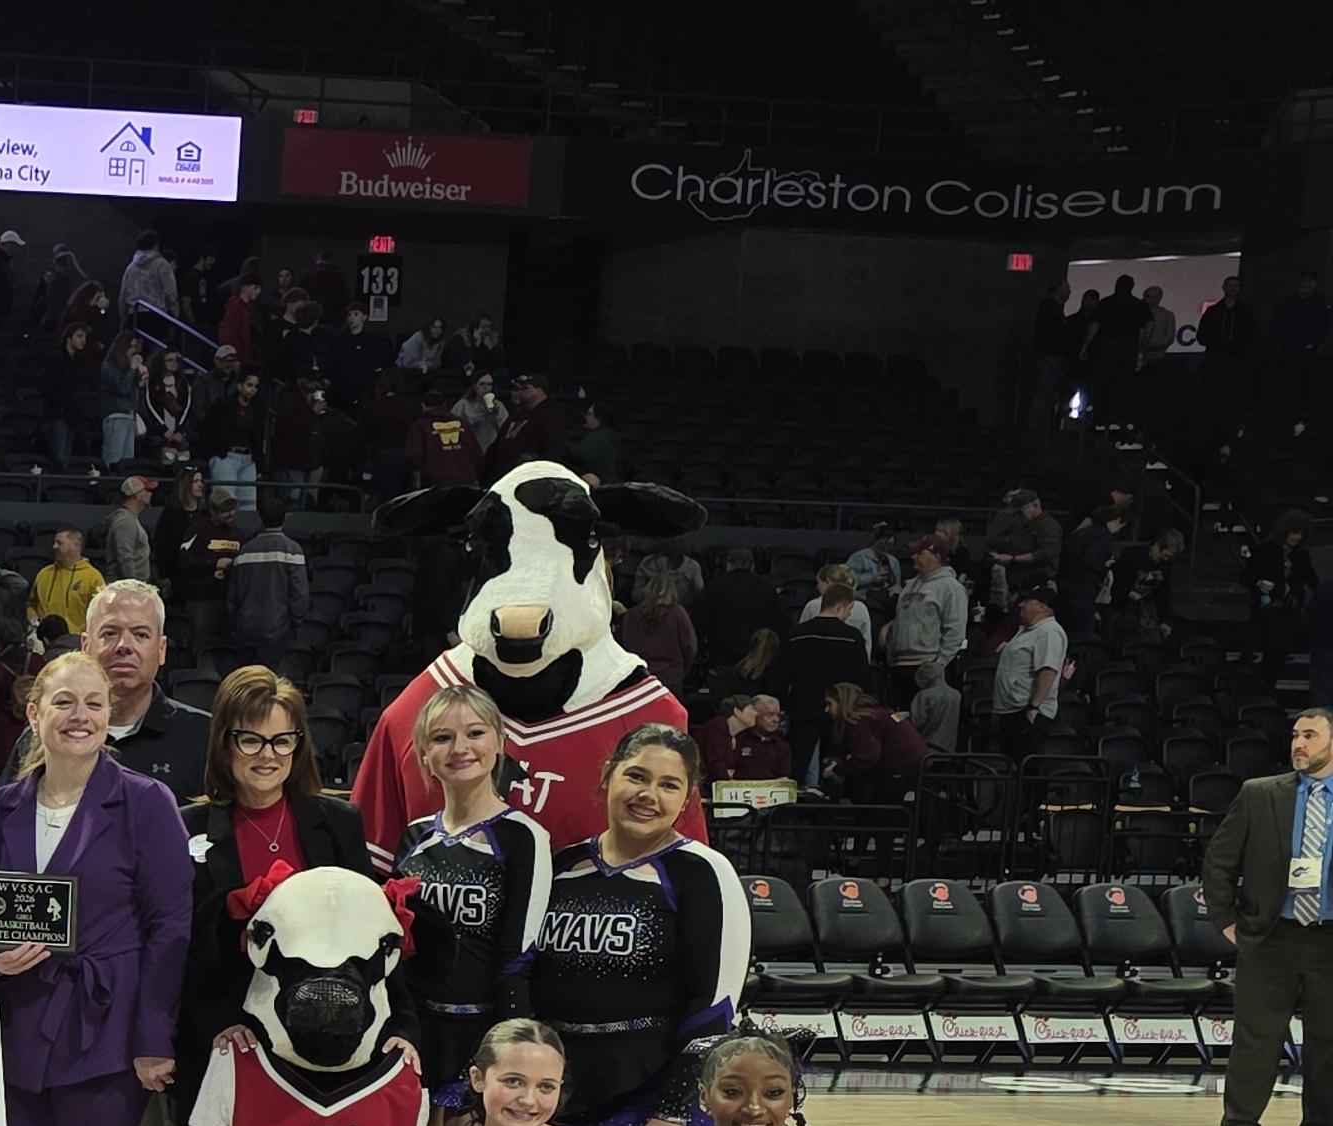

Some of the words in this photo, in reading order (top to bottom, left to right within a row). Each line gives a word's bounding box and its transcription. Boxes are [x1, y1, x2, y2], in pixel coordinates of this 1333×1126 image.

[18, 164, 51, 185] City
[338, 170, 472, 201] Budweiser
[631, 163, 911, 214] Charleston
[925, 181, 1222, 219] Coliseum
[361, 266, 398, 295] 133
[14, 894, 35, 903] 2026
[14, 904, 35, 913] "AA"
[420, 882, 488, 926] AVS
[11, 930, 66, 943] CHAMPION
[538, 911, 637, 954] MAVS
